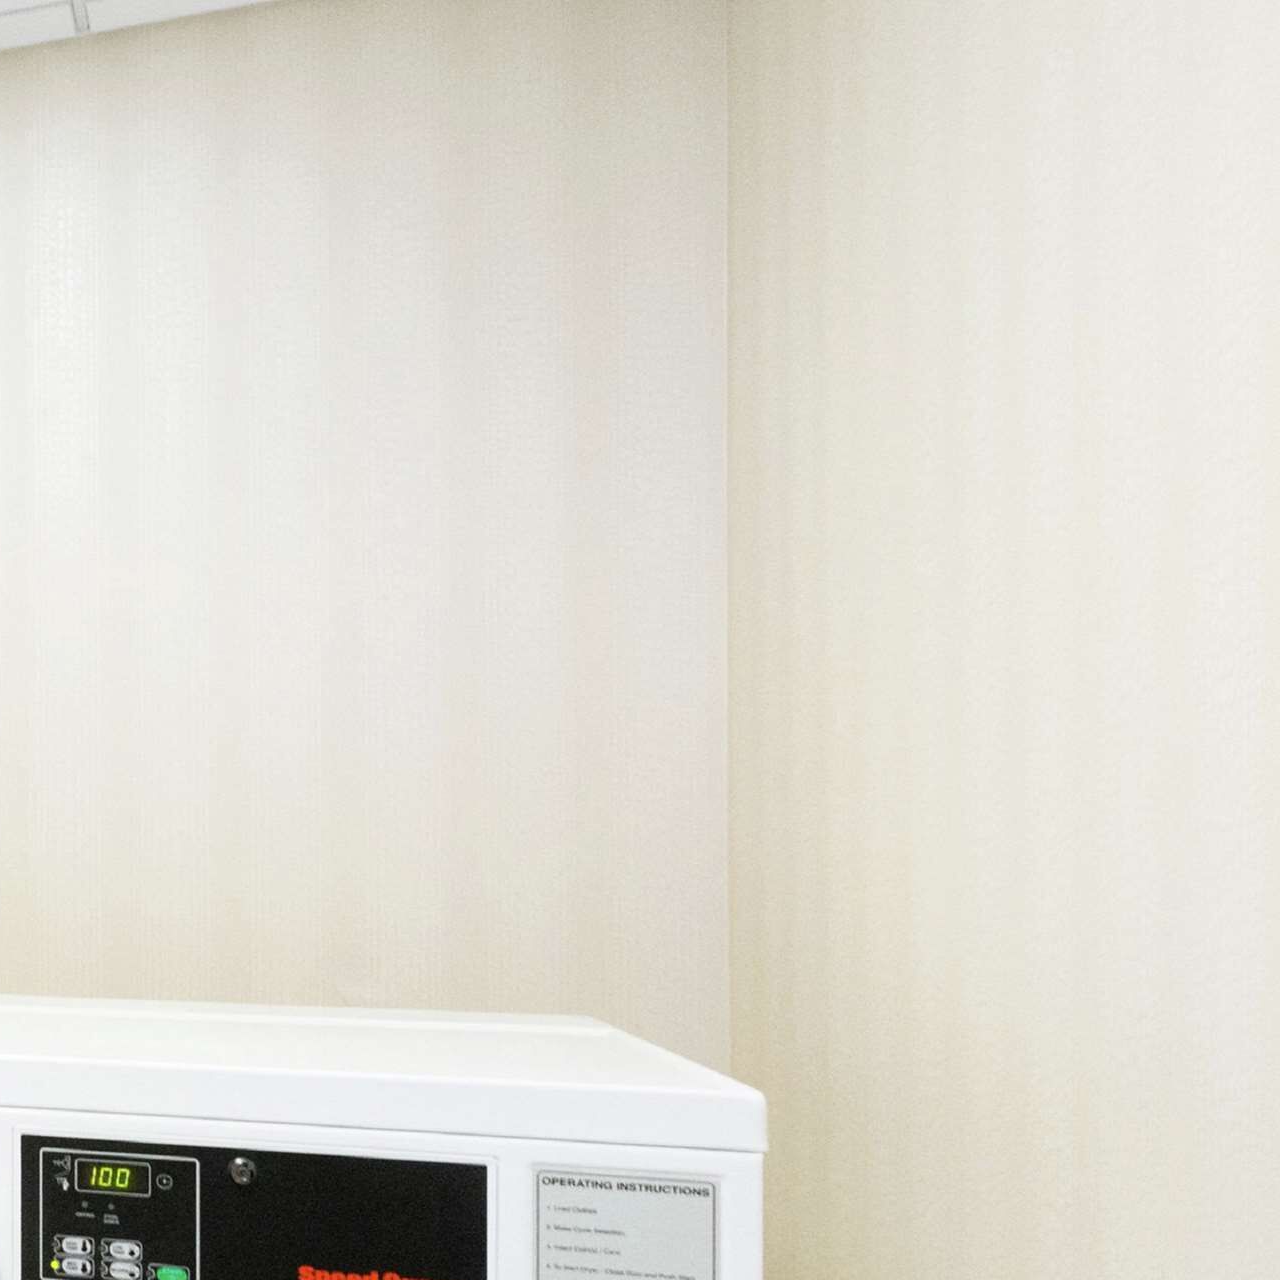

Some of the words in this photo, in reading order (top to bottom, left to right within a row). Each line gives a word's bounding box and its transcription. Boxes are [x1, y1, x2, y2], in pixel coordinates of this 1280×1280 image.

[89, 1165, 131, 1188] 100
[542, 1176, 613, 1190] OPERATING
[616, 1182, 711, 1197] INSTRUCTIONS
